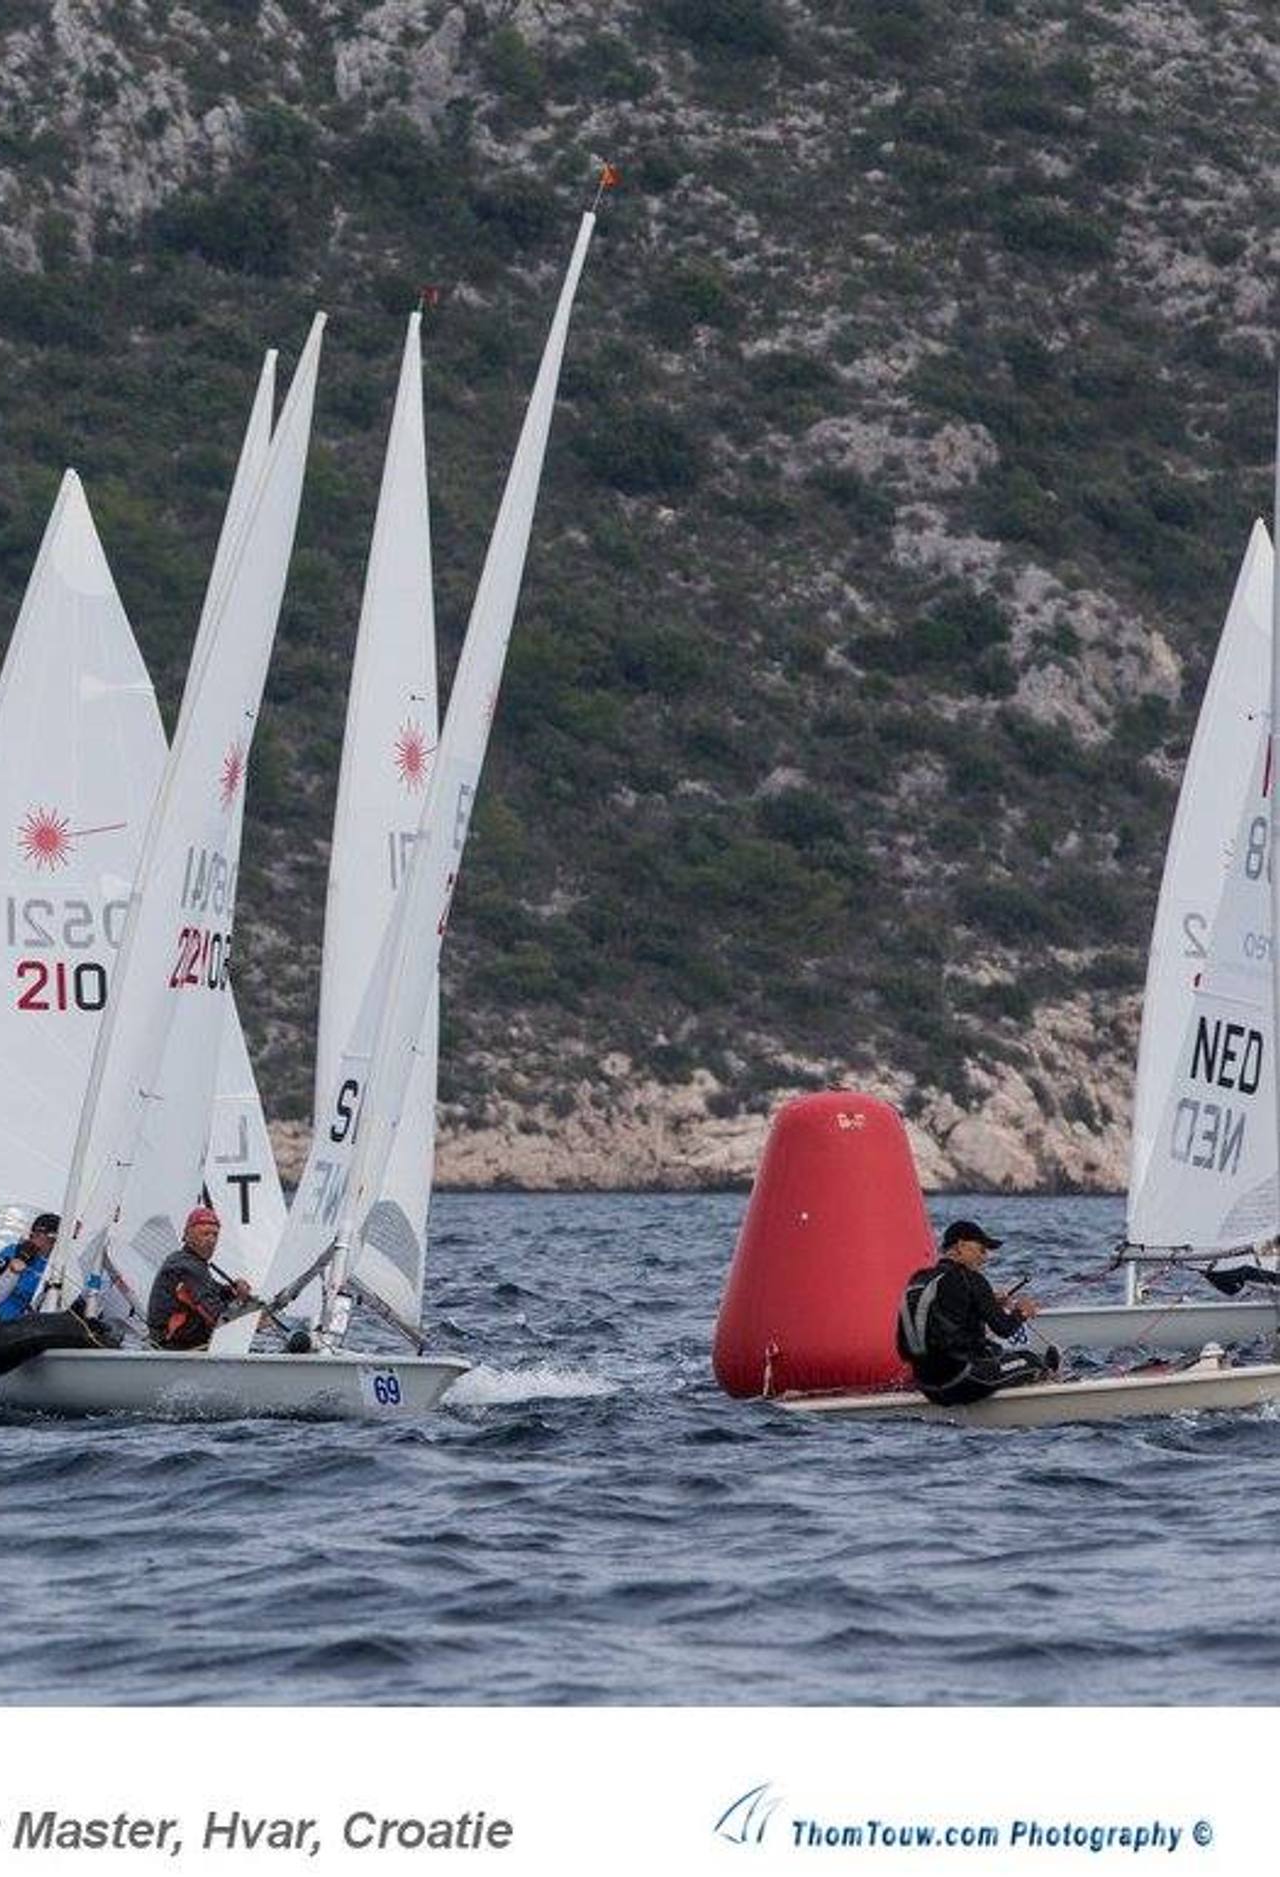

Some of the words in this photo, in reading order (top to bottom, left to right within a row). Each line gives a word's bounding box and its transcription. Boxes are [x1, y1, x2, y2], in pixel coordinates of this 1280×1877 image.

[17, 961, 108, 1011] 210
[1190, 1016, 1264, 1095] NED
[373, 1375, 401, 1406] 69
